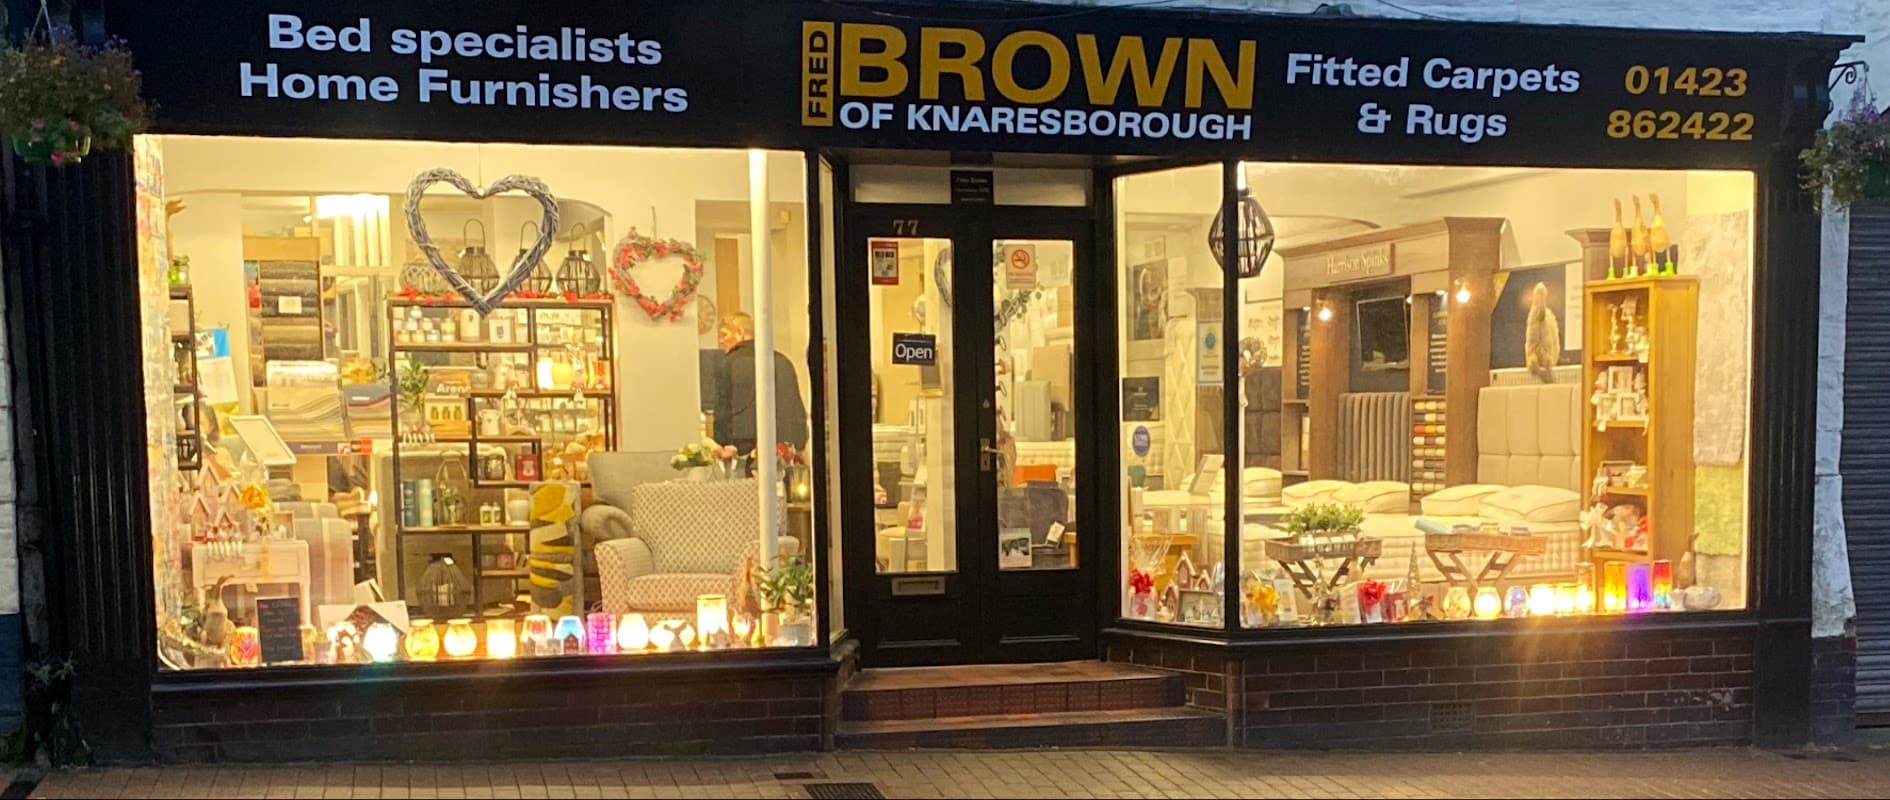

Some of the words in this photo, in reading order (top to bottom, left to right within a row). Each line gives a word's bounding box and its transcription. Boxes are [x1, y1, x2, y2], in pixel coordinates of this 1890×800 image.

[268, 13, 371, 53] Bed
[390, 24, 662, 65] specialists
[808, 30, 828, 118] FRED
[840, 23, 1257, 109] BROWN
[1286, 53, 1410, 88] Fitted
[1423, 57, 1580, 98] Carpets
[1625, 65, 1747, 97] 01423
[239, 62, 399, 103] Home
[417, 68, 688, 113] Furnishers
[840, 102, 894, 130] OF
[907, 103, 1252, 140] KNARESBOROUGH
[1358, 102, 1392, 134] &
[1406, 103, 1507, 143] Rugs
[1606, 110, 1754, 141] 862422
[893, 219, 919, 235] 77
[895, 343, 933, 361] Open
